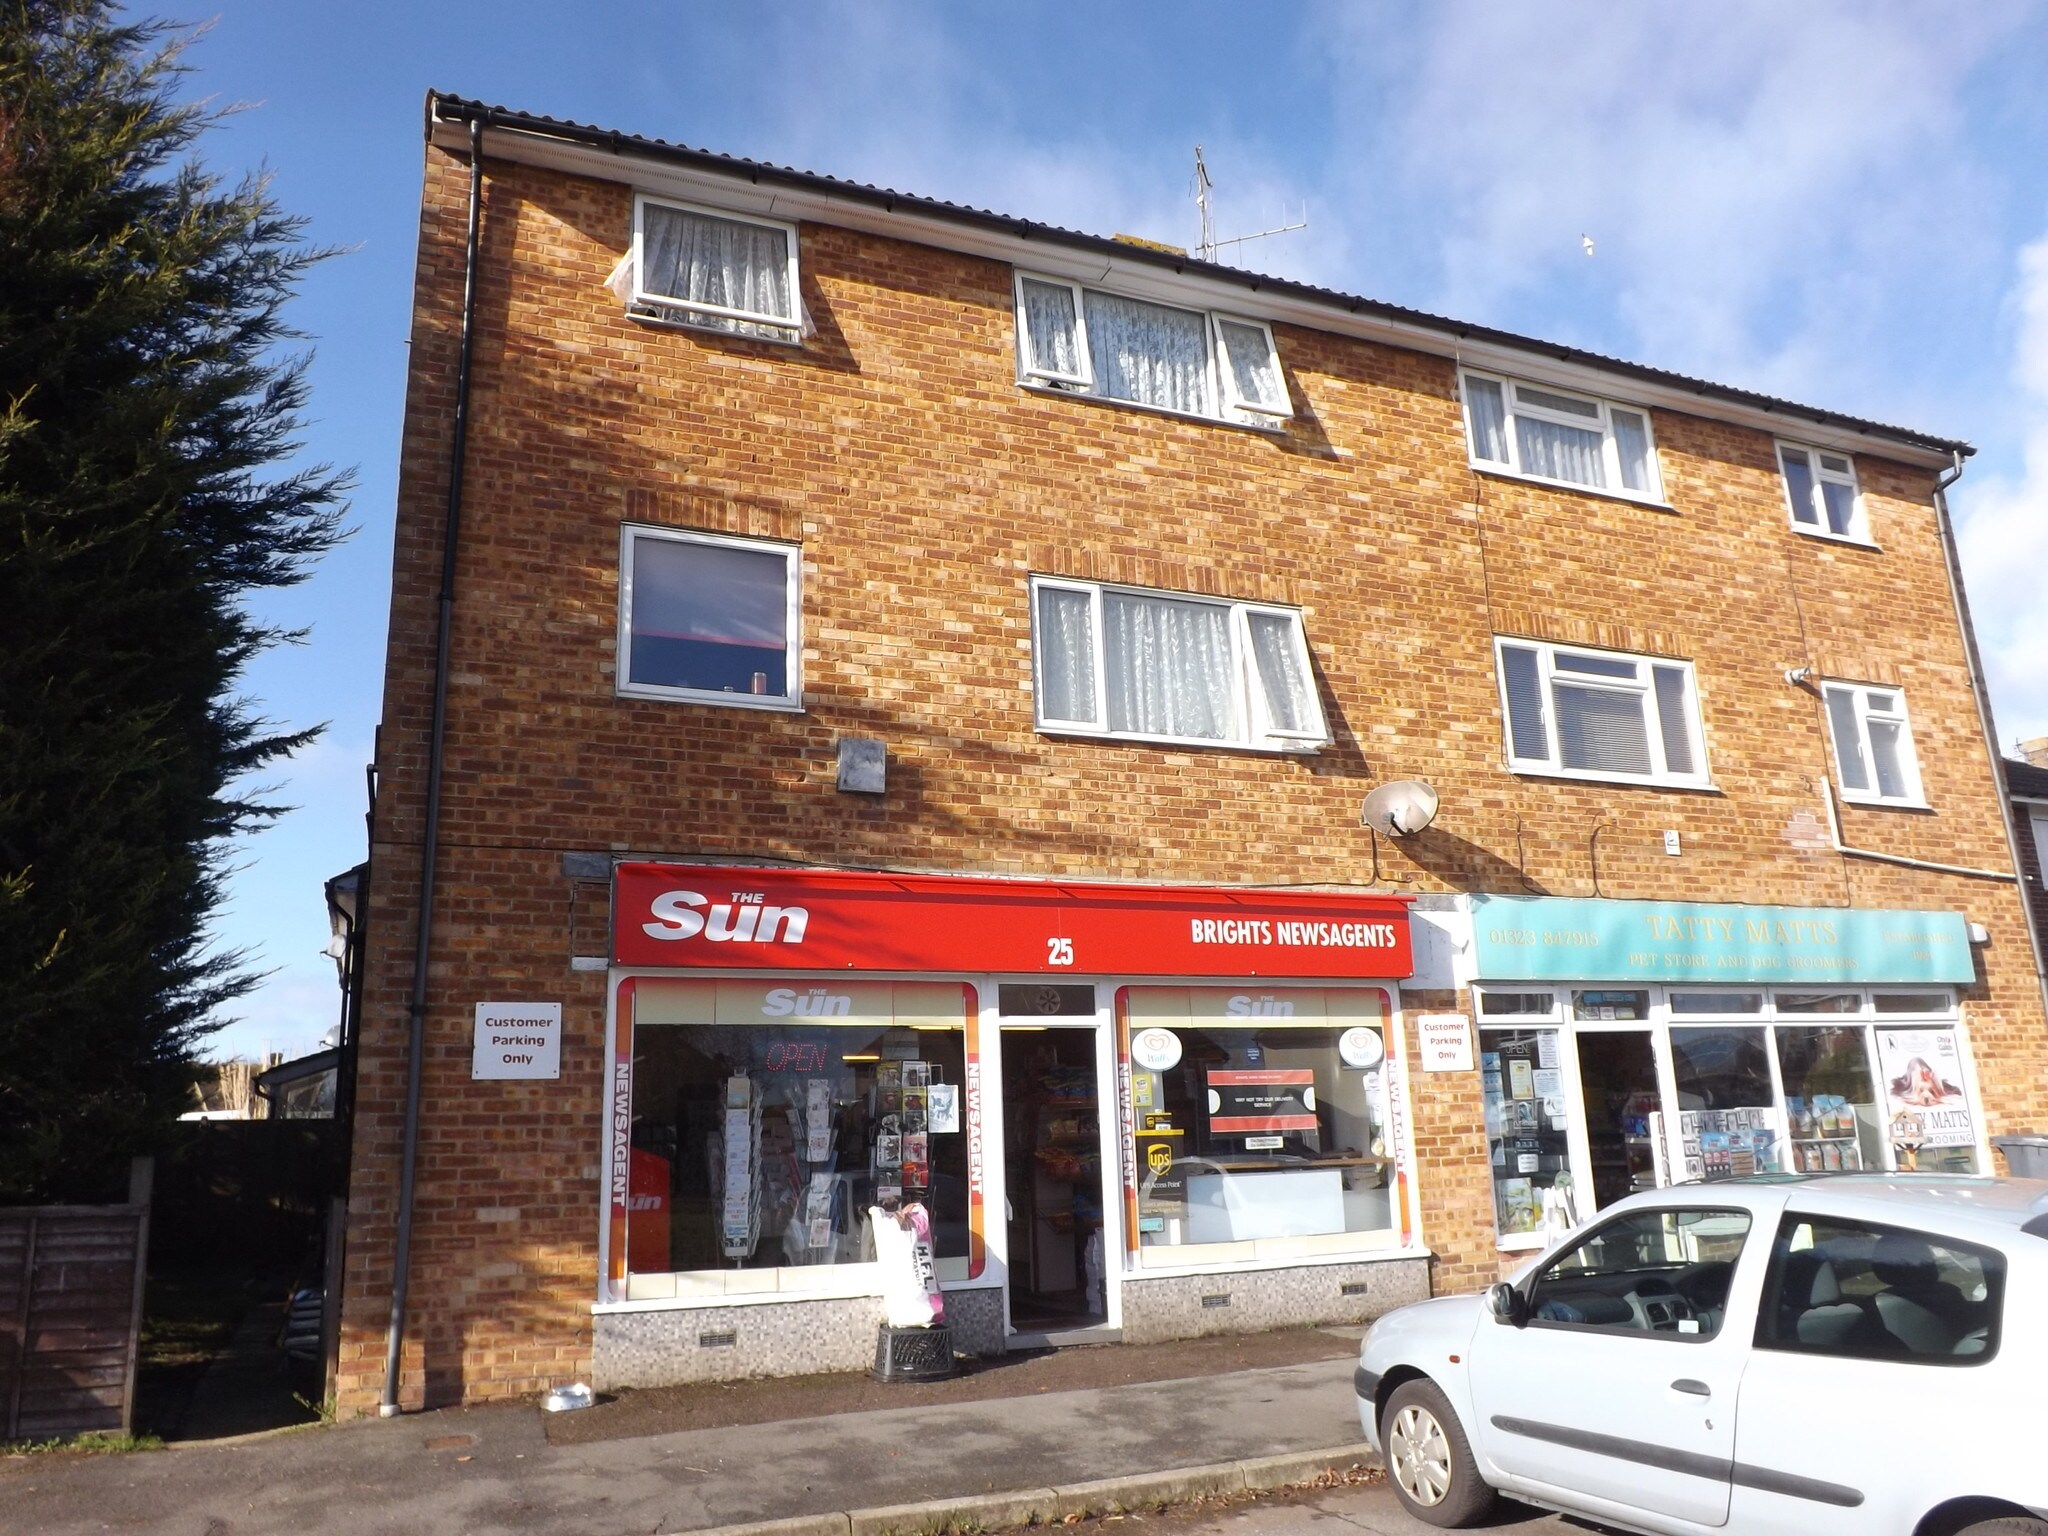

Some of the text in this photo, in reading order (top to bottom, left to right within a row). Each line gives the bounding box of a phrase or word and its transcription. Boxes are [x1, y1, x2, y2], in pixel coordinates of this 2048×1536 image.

[731, 892, 765, 904] THE
[642, 890, 810, 944] Sun
[1191, 918, 1396, 948] BRIGHTS NEWSAGENTS
[1489, 929, 1536, 945] 01323
[1645, 915, 1839, 945] TATTY MATTS
[1047, 938, 1074, 965] 25
[1628, 953, 1859, 969] PET STORE AND DOG GROOMERS
[808, 988, 828, 996] THE
[761, 988, 852, 1017] Sun
[1226, 995, 1295, 1020] Sun
[485, 1016, 554, 1028] Customer
[1424, 1023, 1464, 1031] Customer
[492, 1035, 546, 1047] Parking
[1430, 1037, 1462, 1046] Parking
[1506, 1044, 1528, 1054] OPEN
[502, 1053, 534, 1066] Only
[766, 1043, 829, 1072] OPEN
[1438, 1051, 1456, 1060] Only
[1387, 1059, 1408, 1172] NEWSAGENT
[1930, 1110, 1970, 1129] MATTS
[612, 1063, 630, 1207] NEWSAGENT
[967, 1062, 984, 1195] NEWSAGENT
[1118, 1062, 1136, 1190] NEWSAGENT
[1931, 1133, 1973, 1144] OOMING
[628, 1193, 661, 1211] un
